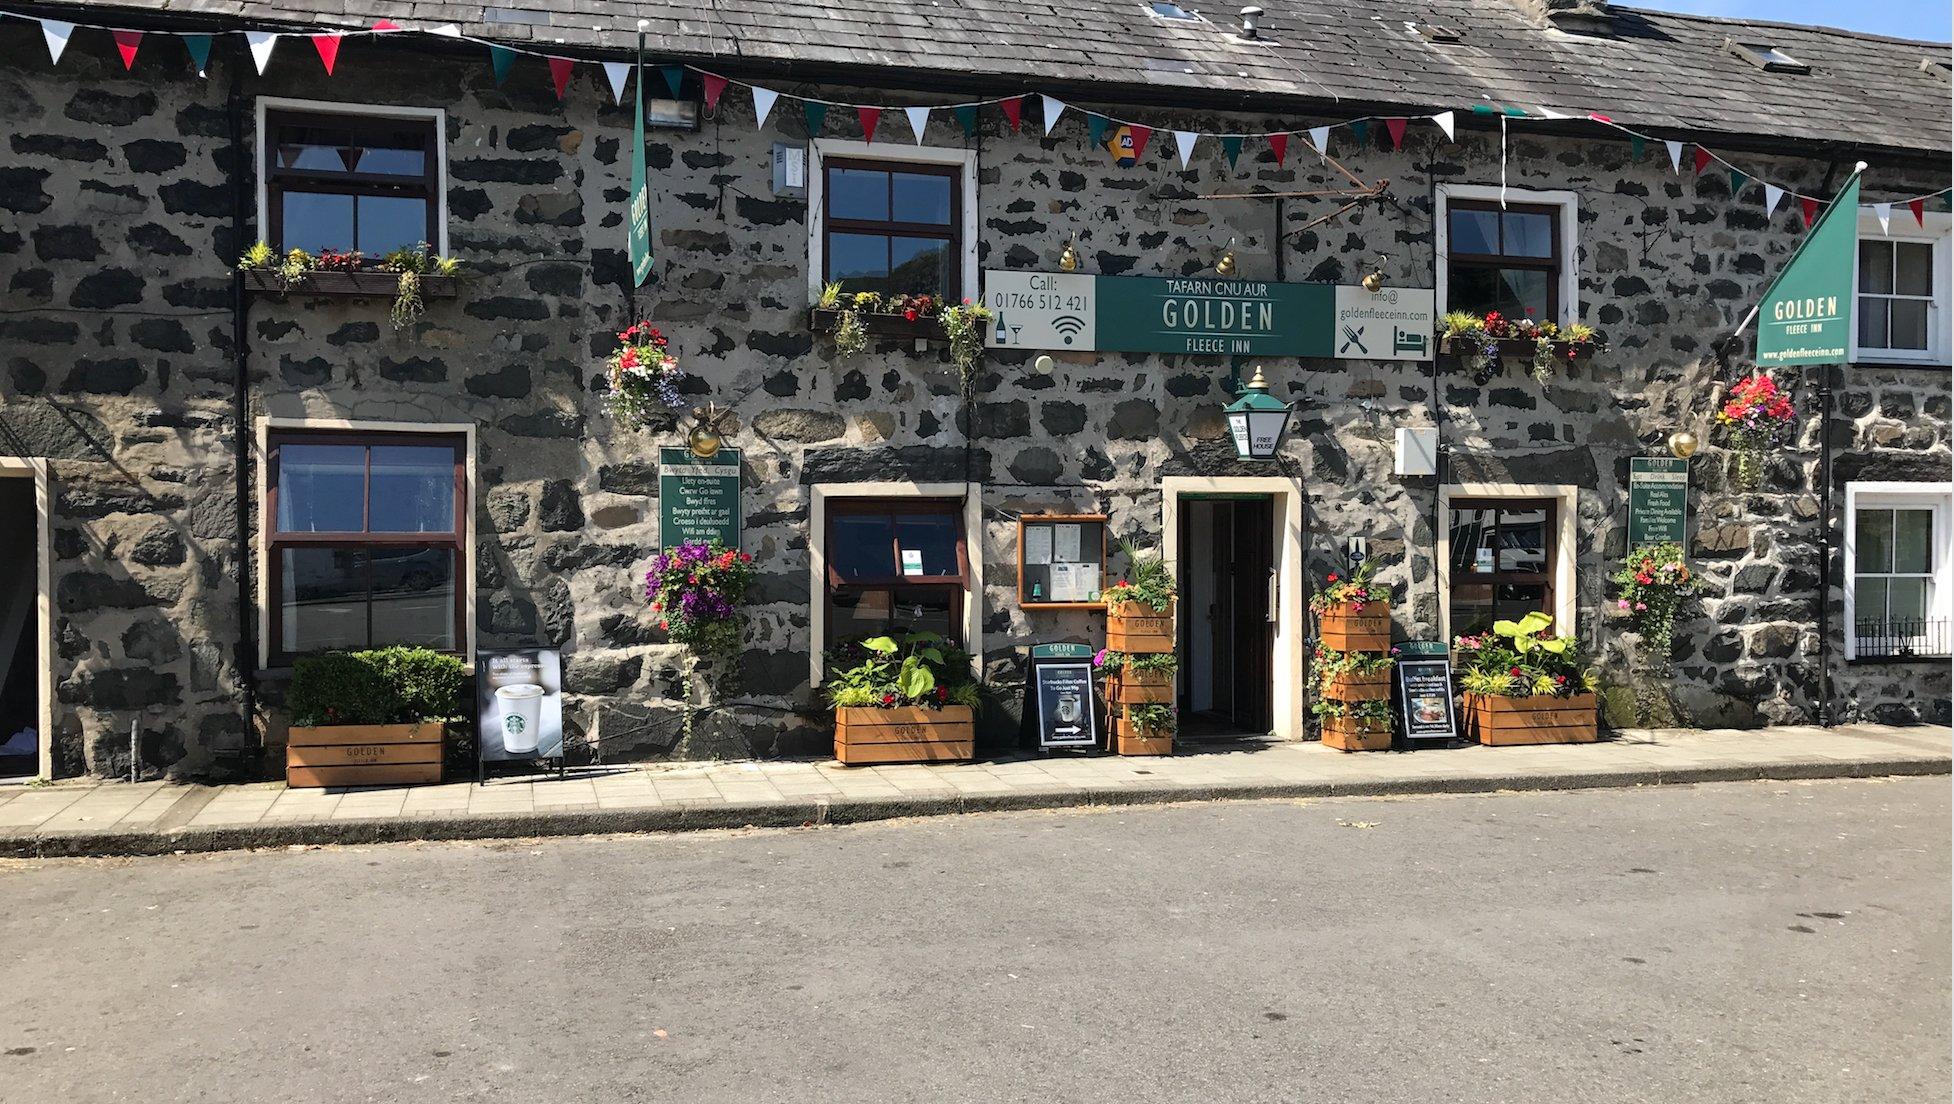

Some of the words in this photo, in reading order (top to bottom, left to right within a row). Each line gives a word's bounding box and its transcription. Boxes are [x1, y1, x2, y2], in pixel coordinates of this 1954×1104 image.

[1121, 136, 1134, 148] AD
[1029, 275, 1057, 291] Call:
[1166, 280, 1212, 295] TAFARN
[1214, 282, 1241, 296] CNU
[1243, 283, 1268, 297] AUR
[995, 292, 1034, 309] 01766
[1039, 294, 1062, 310] 512
[1066, 295, 1087, 311] 421
[1371, 290, 1398, 304] info@
[1339, 306, 1428, 321] goldenfleeceinn.com
[1774, 296, 1837, 320] GOLDEN
[1162, 299, 1272, 331] GOLDEN
[1786, 324, 1808, 335] FLEECE
[1810, 323, 1823, 333] INN
[1186, 338, 1224, 353] FLEECE
[1231, 339, 1251, 353] INN
[1763, 347, 1845, 361] www.goldenfleeceinn.com
[698, 486, 709, 495] Go
[686, 496, 703, 507] Bwyd
[672, 517, 696, 525] Croeso
[1135, 619, 1165, 628] GOLDEN
[1049, 644, 1076, 652] GOLDEN
[1531, 711, 1559, 721] GOLDEN
[894, 725, 927, 735] GOLDEN
[346, 747, 386, 757] GOLDEN
